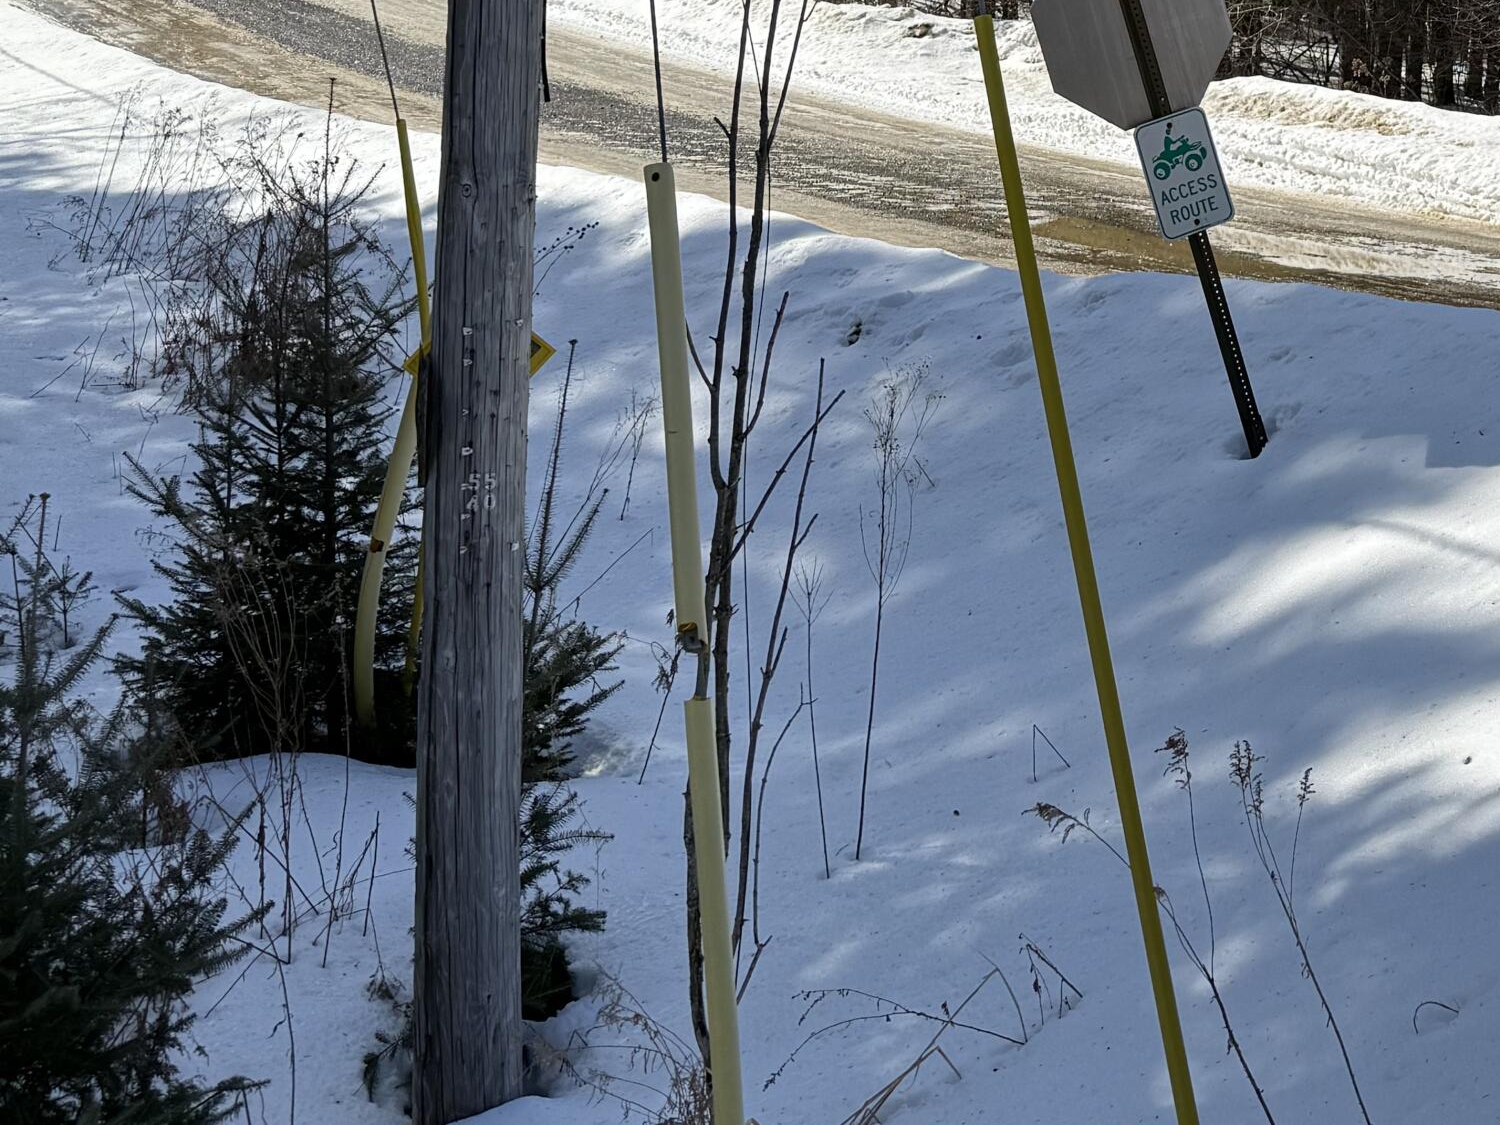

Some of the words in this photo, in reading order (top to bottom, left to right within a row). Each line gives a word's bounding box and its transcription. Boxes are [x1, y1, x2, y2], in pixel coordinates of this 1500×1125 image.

[1161, 174, 1217, 206] ACCESS
[1170, 196, 1219, 225] ROUTE
[469, 472, 496, 490] 55
